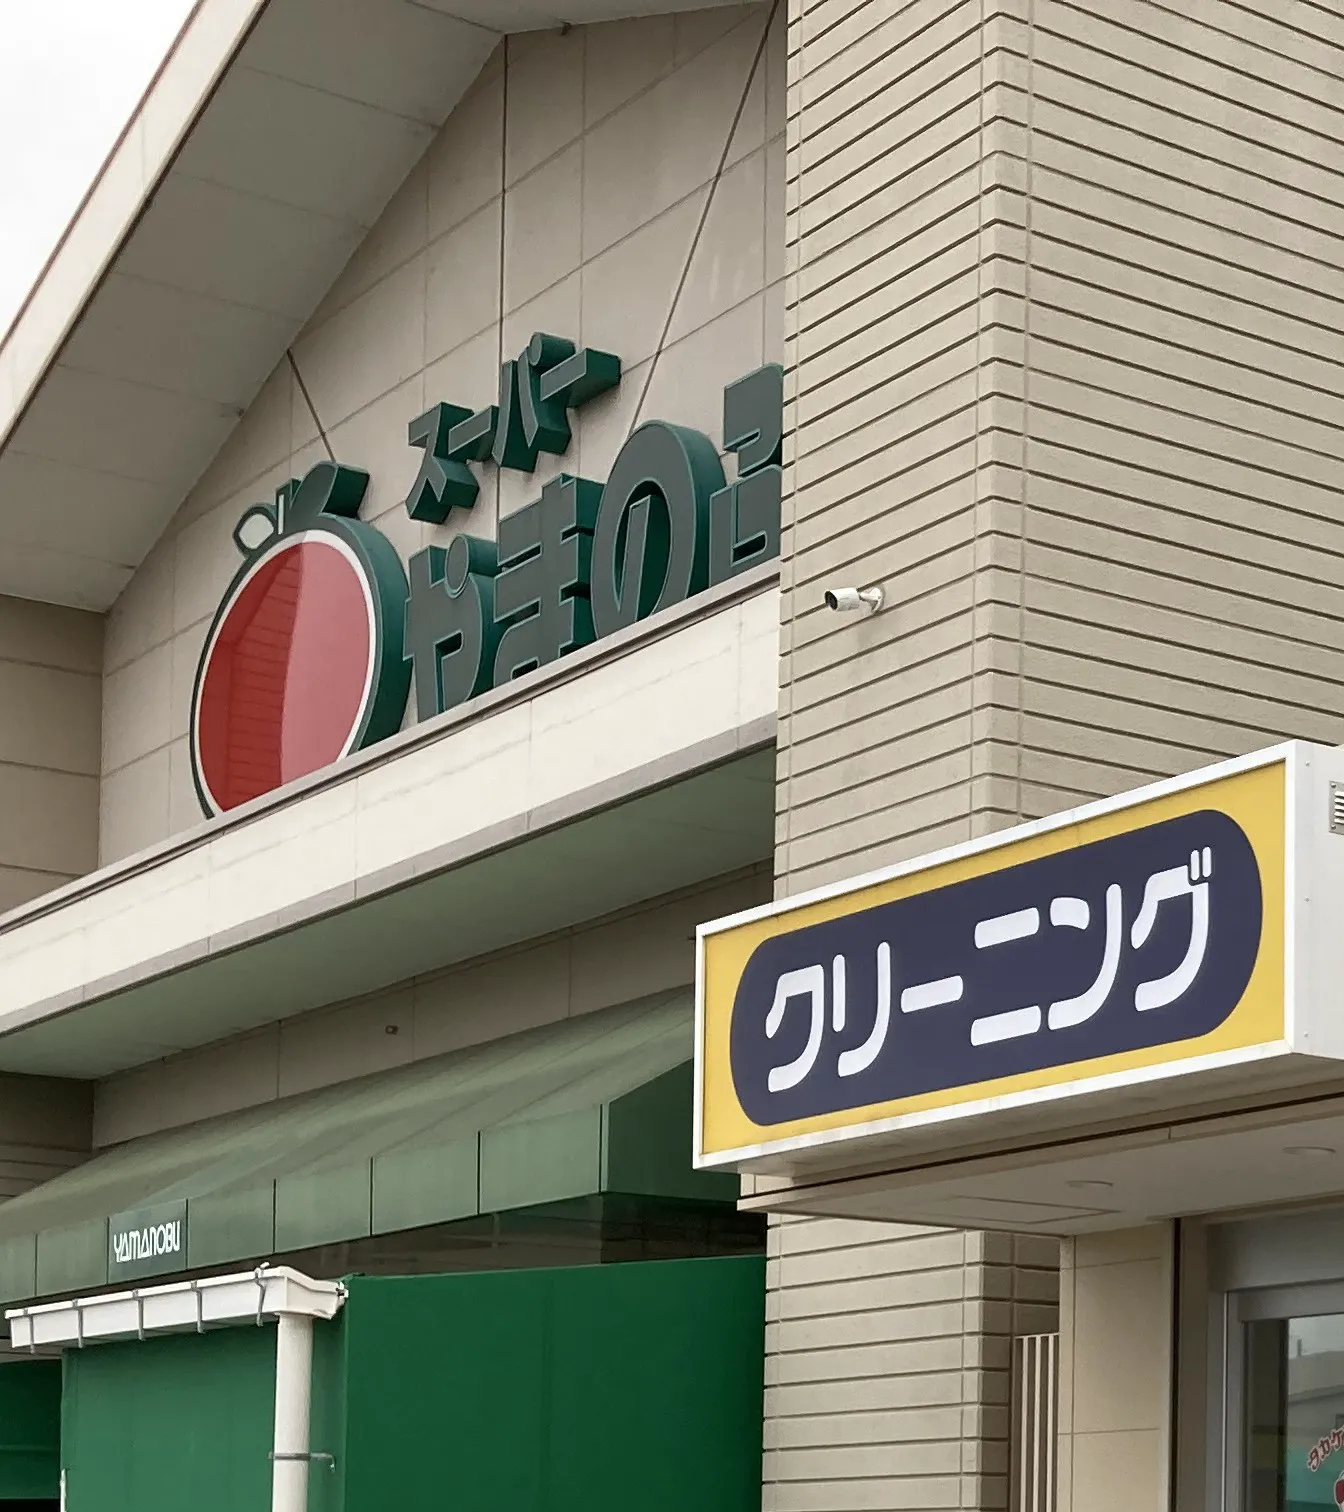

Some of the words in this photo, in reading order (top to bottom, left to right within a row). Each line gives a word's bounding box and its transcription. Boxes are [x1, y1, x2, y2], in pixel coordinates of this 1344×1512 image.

[406, 332, 622, 524] スーパー
[765, 846, 1212, 1093] クリーニング
[113, 1219, 181, 1263] YAMANOBU
